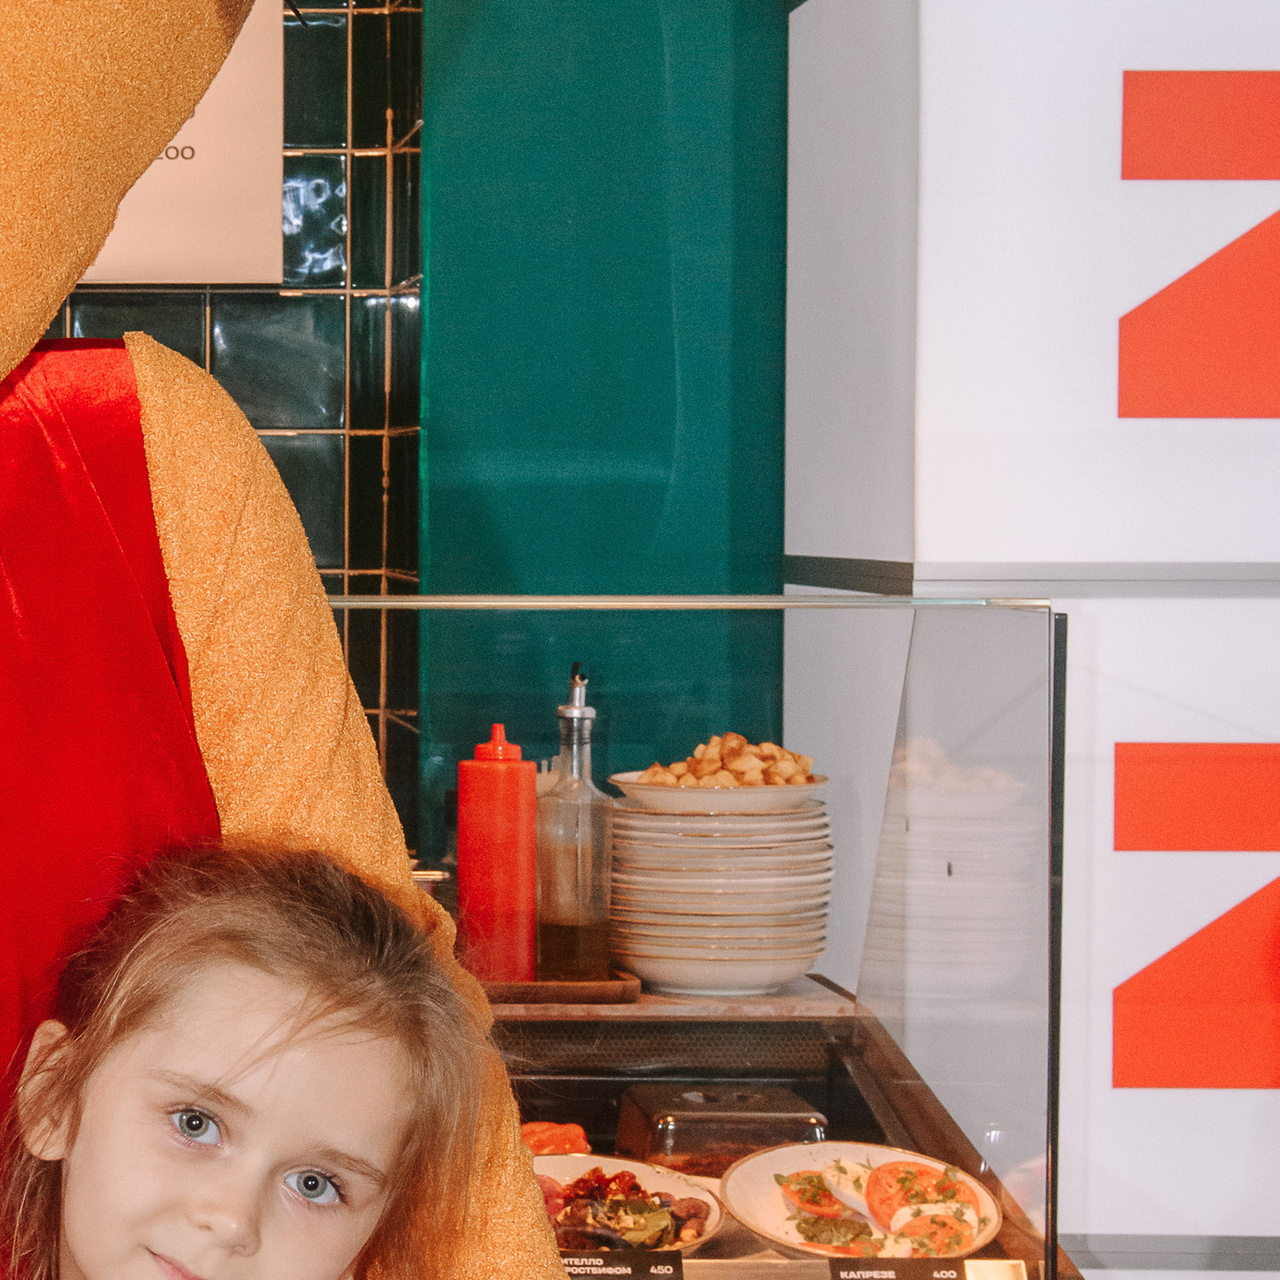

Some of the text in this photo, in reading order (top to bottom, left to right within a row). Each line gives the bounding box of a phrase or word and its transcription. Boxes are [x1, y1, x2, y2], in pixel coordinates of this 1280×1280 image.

[559, 1257, 604, 1266] ИТЕЛЛО
[649, 1265, 674, 1275] 450
[840, 1269, 958, 1280] КАПРЕЗЕ 400
